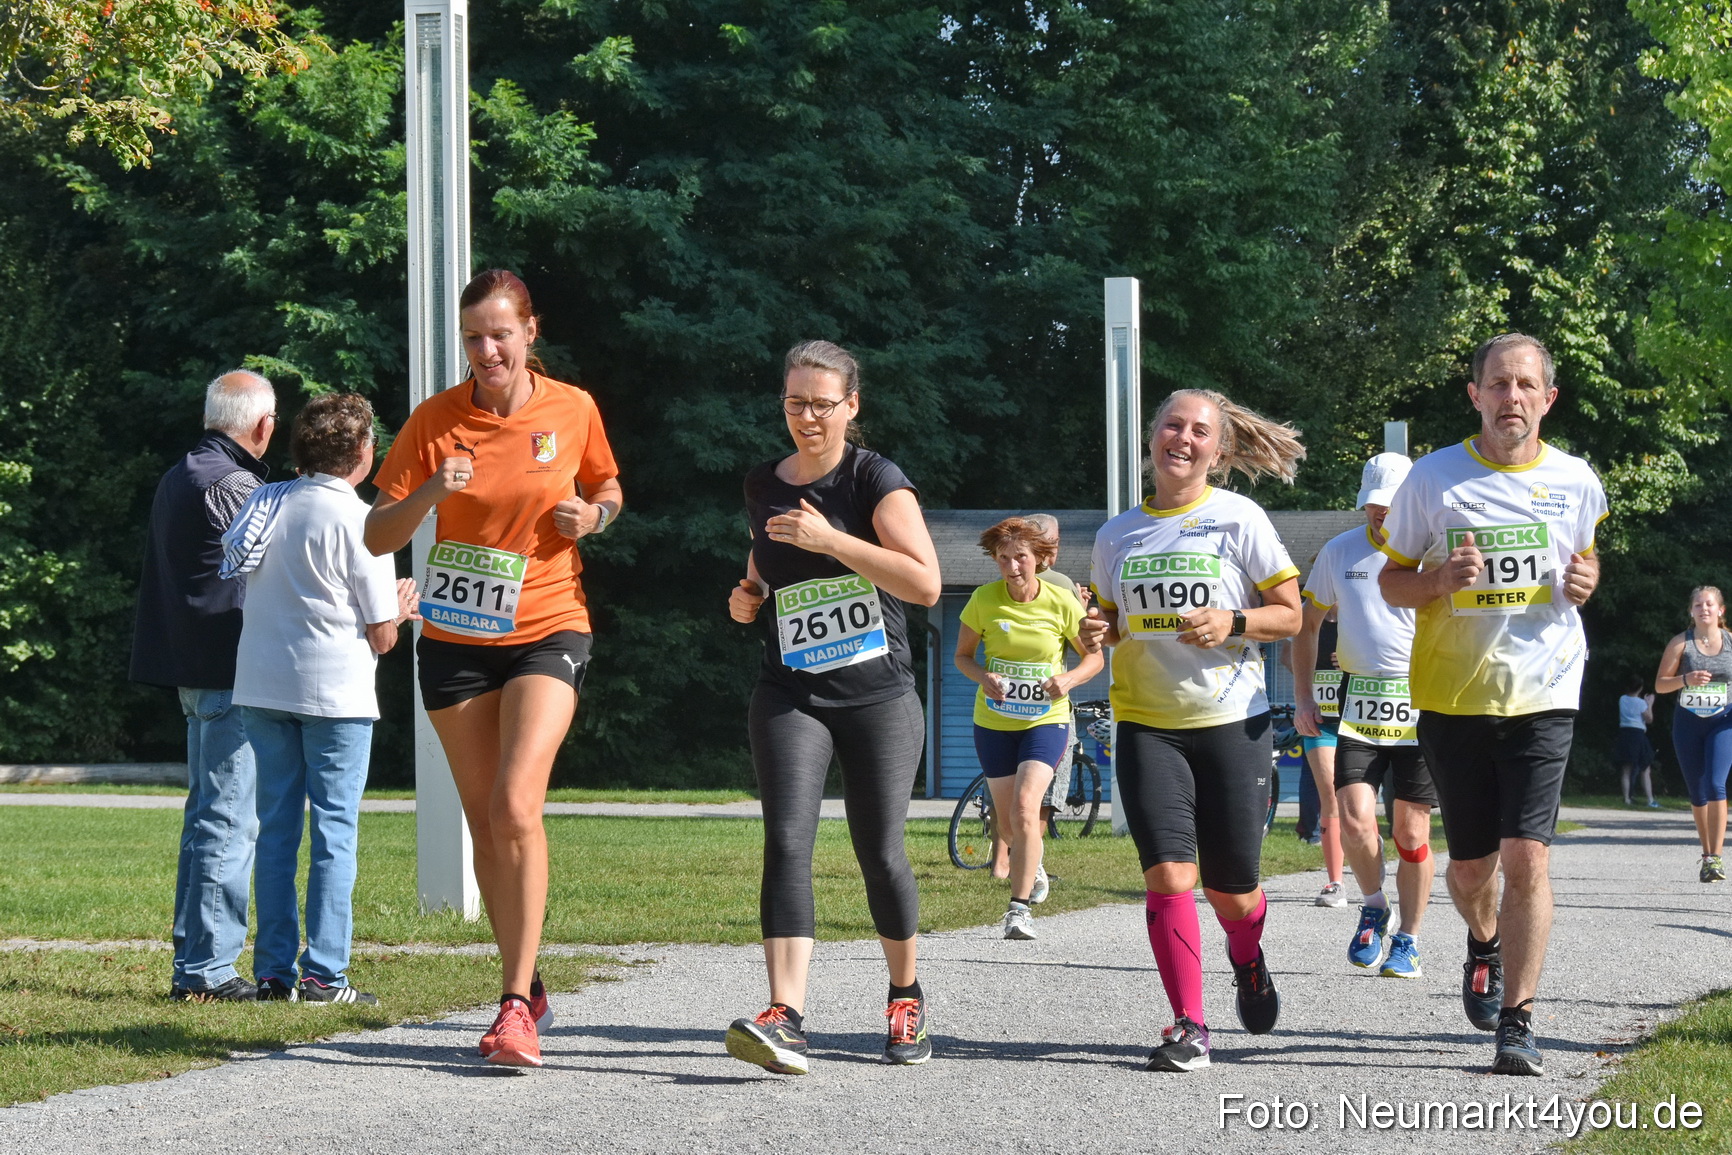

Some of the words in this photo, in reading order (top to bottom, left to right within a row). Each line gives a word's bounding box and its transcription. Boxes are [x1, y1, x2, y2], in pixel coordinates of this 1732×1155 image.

[434, 544, 517, 577] BOCK
[1128, 555, 1213, 576] BOCK
[1483, 555, 1537, 584] 191
[432, 572, 505, 611] 2611
[782, 576, 866, 612] BOCK
[1132, 582, 1210, 609] 1190
[1476, 592, 1526, 605] PETER
[431, 608, 500, 631] BARBARA
[789, 602, 870, 646] 2610
[804, 639, 865, 664] NADINE
[993, 661, 1046, 677] BOCK
[1352, 678, 1410, 695] BOCK
[993, 702, 1043, 715] GERLINDE
[1355, 700, 1409, 722] 1296
[1686, 695, 1720, 707] 2112
[1356, 726, 1402, 737] HARALD
